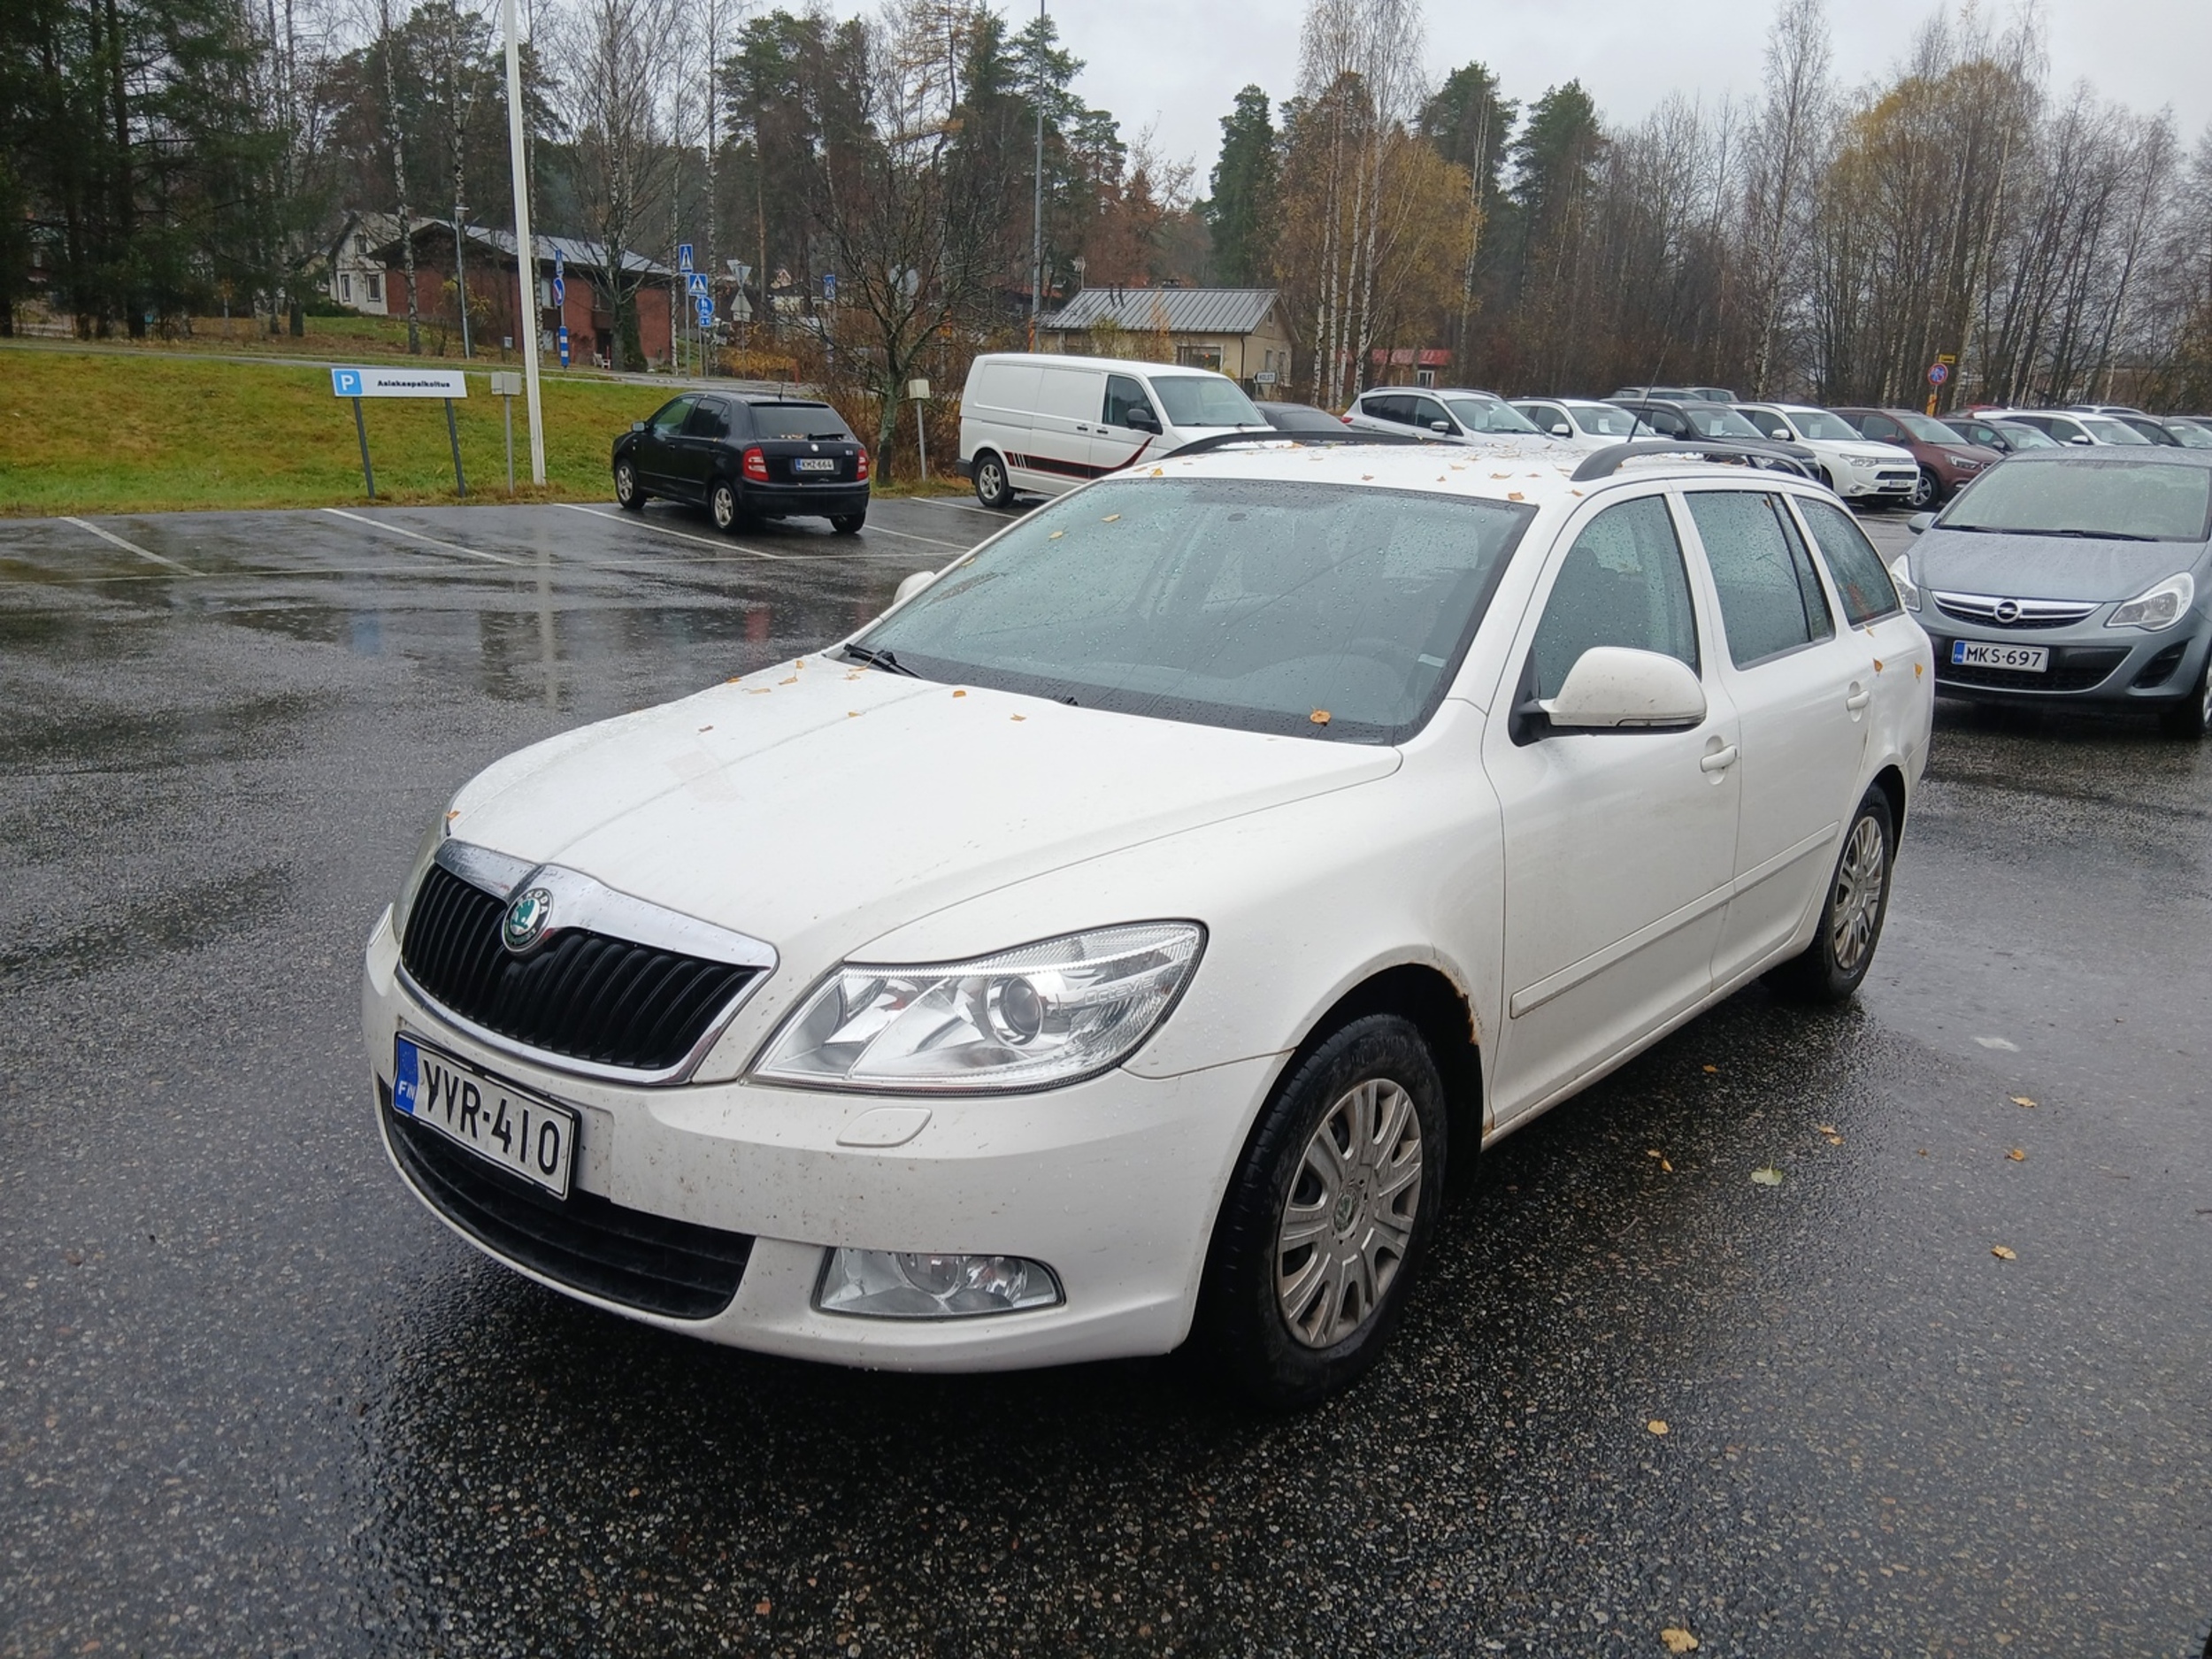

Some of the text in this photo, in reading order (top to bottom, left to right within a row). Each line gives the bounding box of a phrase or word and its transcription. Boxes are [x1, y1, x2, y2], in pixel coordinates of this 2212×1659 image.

[341, 374, 354, 391] P
[1966, 647, 2043, 667] MKS-697
[398, 1059, 561, 1176] FIN YVR-410
